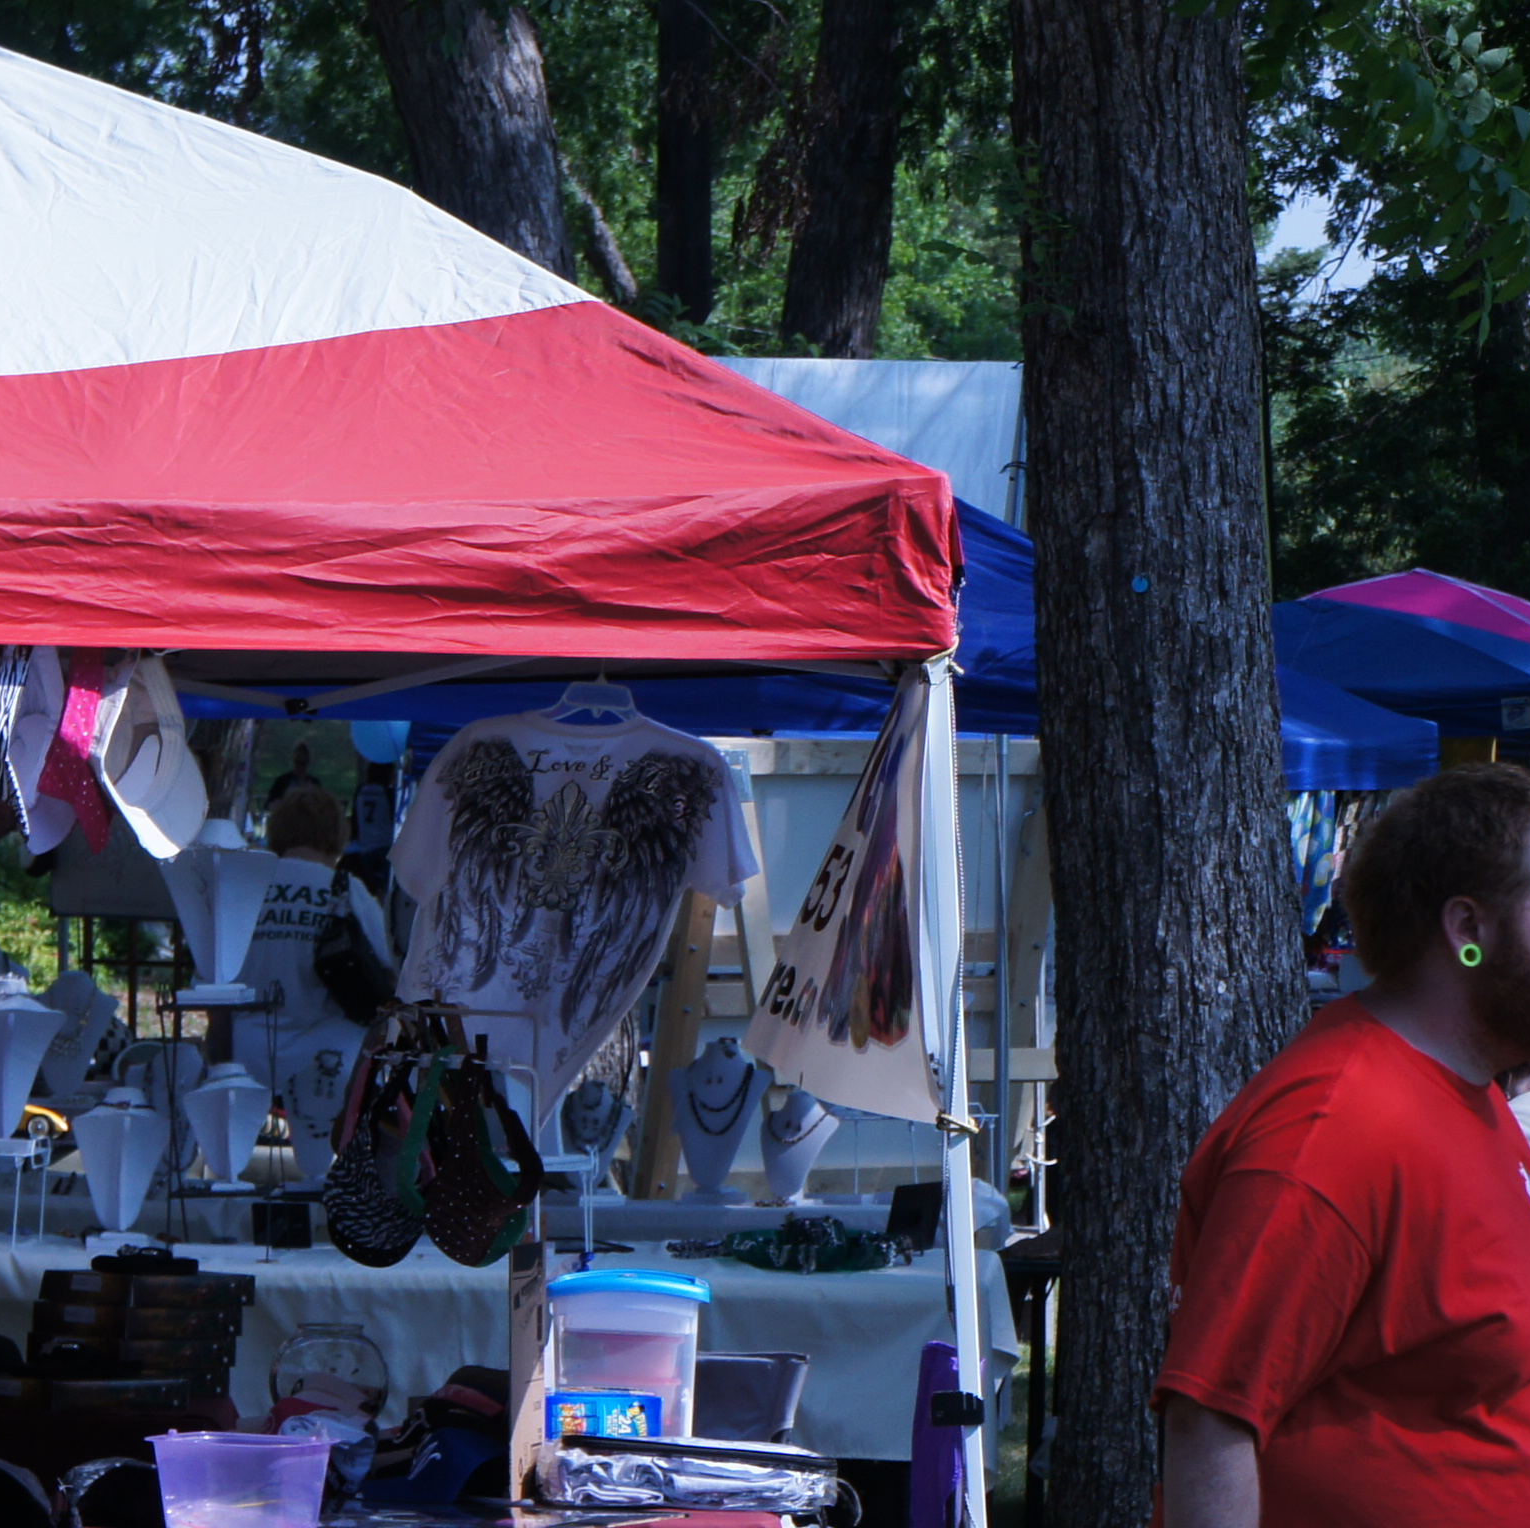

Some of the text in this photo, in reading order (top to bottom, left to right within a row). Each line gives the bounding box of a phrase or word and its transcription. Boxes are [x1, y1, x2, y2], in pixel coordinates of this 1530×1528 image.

[525, 748, 586, 775] Love
[589, 754, 614, 781] &
[363, 800, 377, 824] 7
[257, 908, 326, 929] AILER
[618, 1414, 632, 1435] 24
